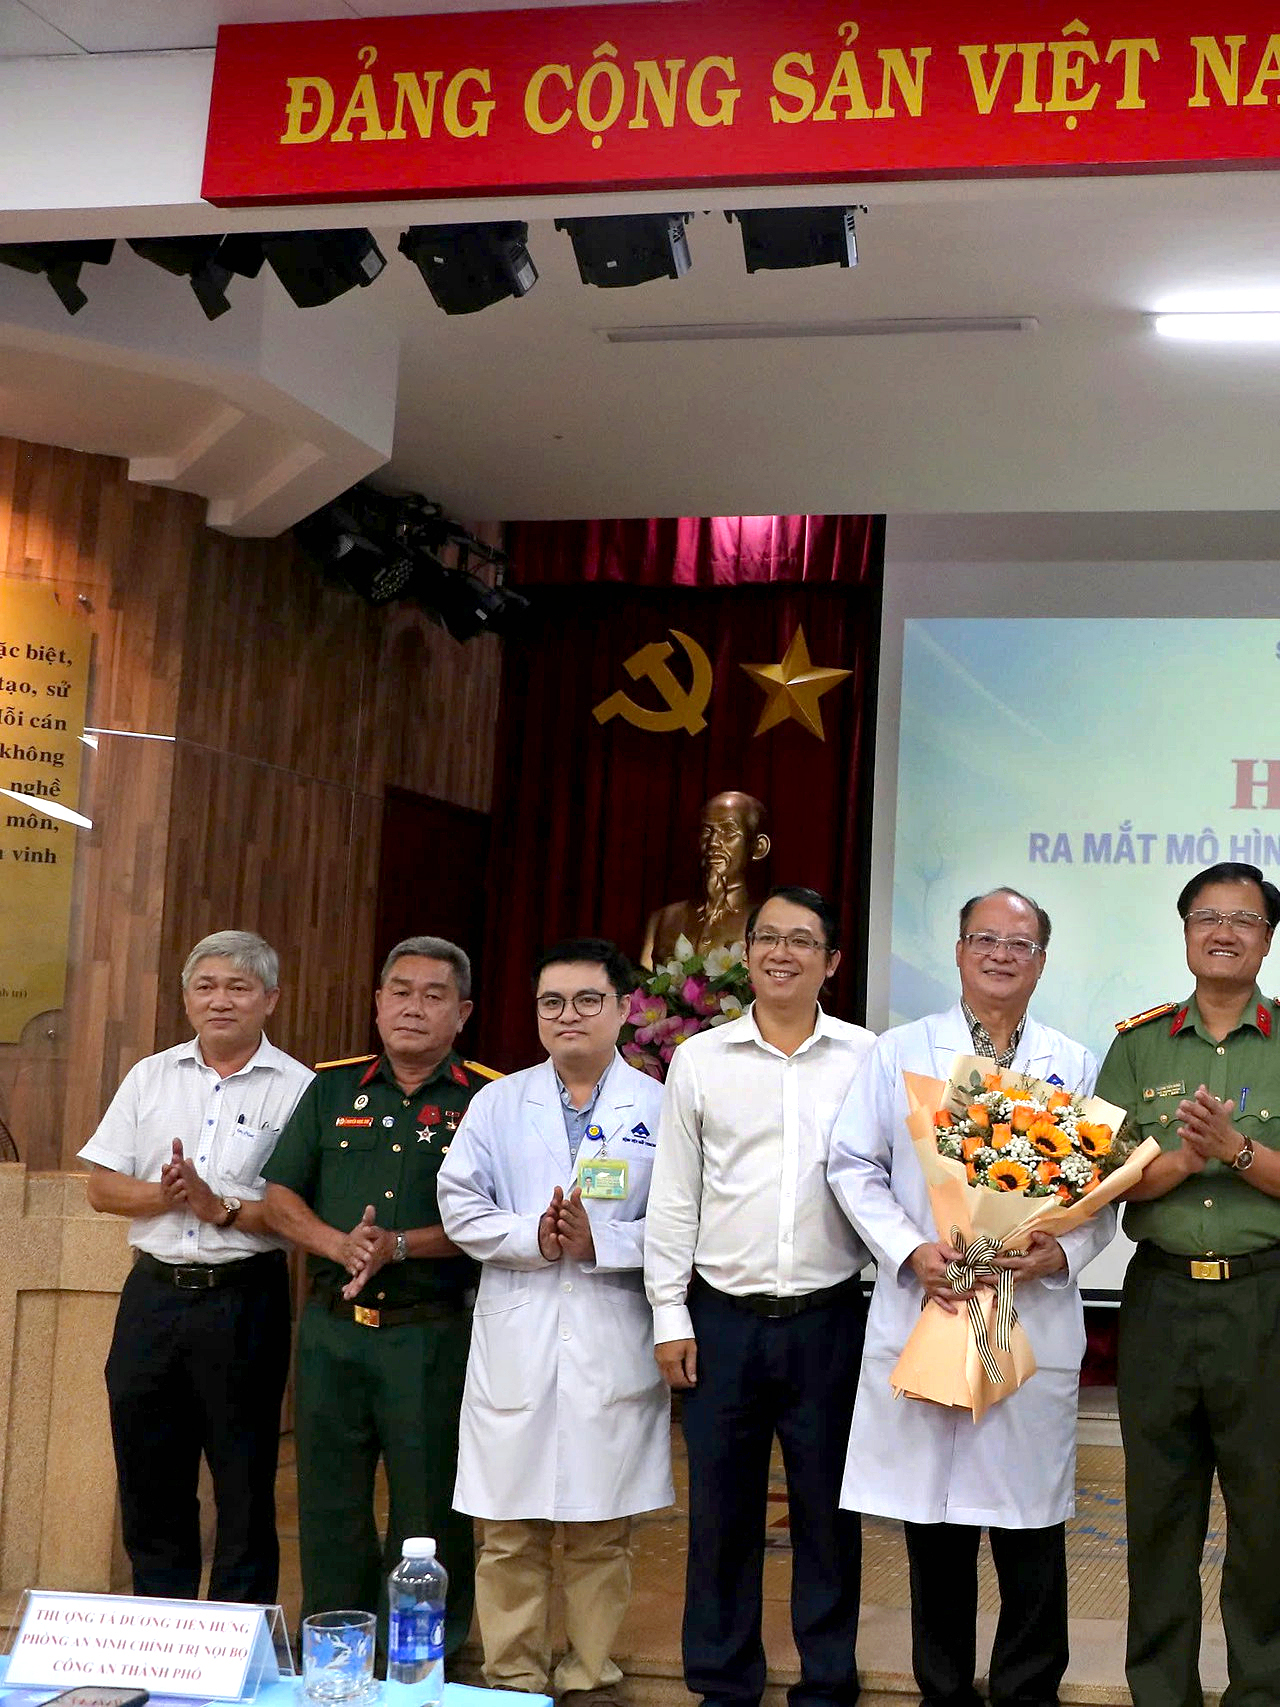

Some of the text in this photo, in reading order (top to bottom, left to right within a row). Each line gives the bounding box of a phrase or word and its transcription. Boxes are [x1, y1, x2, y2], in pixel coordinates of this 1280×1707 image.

[281, 46, 495, 145] ĐẢNG
[524, 42, 740, 149] CỘNG
[769, 22, 931, 124] SẢN
[958, 20, 1160, 131] VIỆT
[26, 644, 73, 668] biệt,
[0, 706, 67, 731] ỗi cán
[0, 742, 64, 768] không
[6, 813, 59, 833] môn,
[1029, 832, 1073, 864] RA
[1083, 820, 1158, 865] MẮT
[1166, 828, 1220, 865] MÔ
[12, 847, 57, 864] vinh
[95, 1638, 127, 1650] NINH
